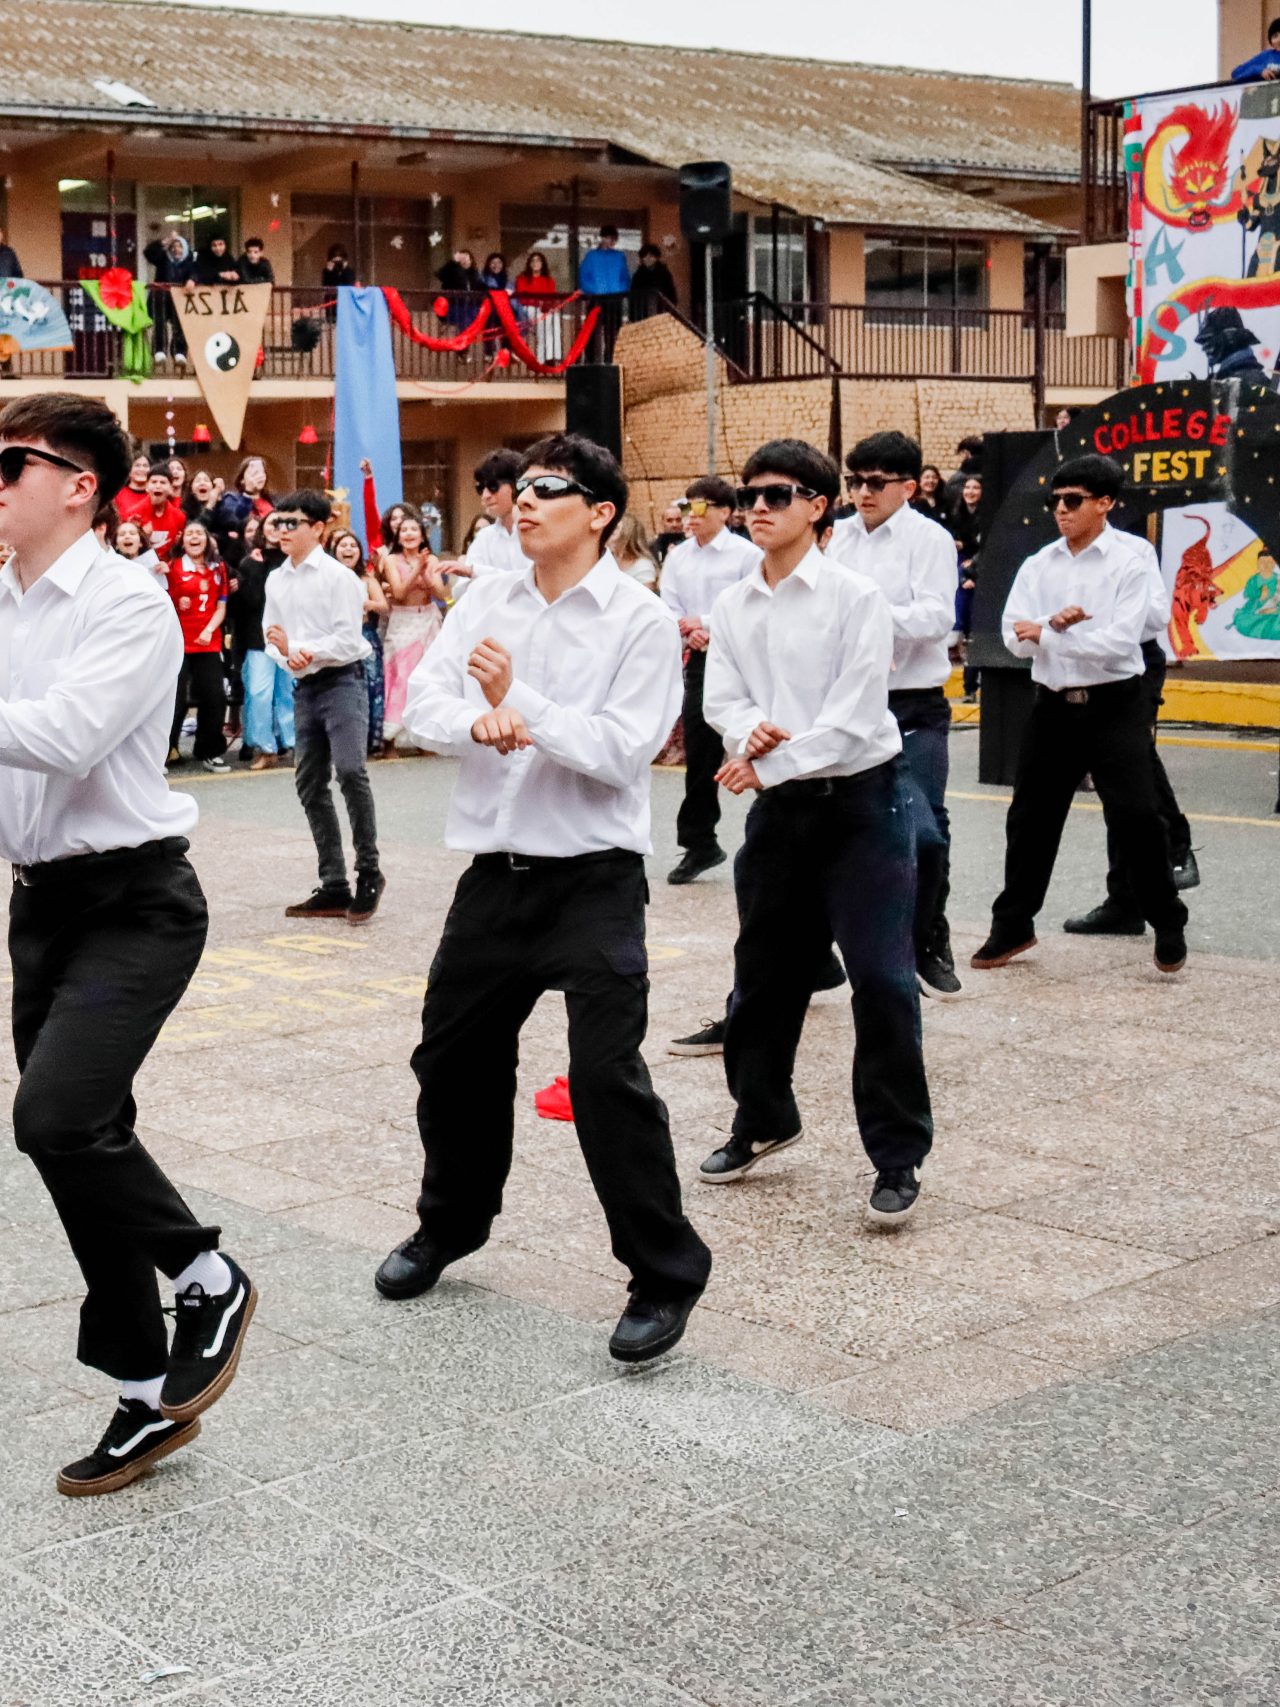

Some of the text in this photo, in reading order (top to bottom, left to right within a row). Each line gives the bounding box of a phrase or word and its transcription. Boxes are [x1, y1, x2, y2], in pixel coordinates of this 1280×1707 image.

[183, 289, 248, 315] ASIA
[1093, 408, 1231, 454] COLLEGE
[1133, 450, 1211, 482] FEST
[199, 594, 208, 611] 7
